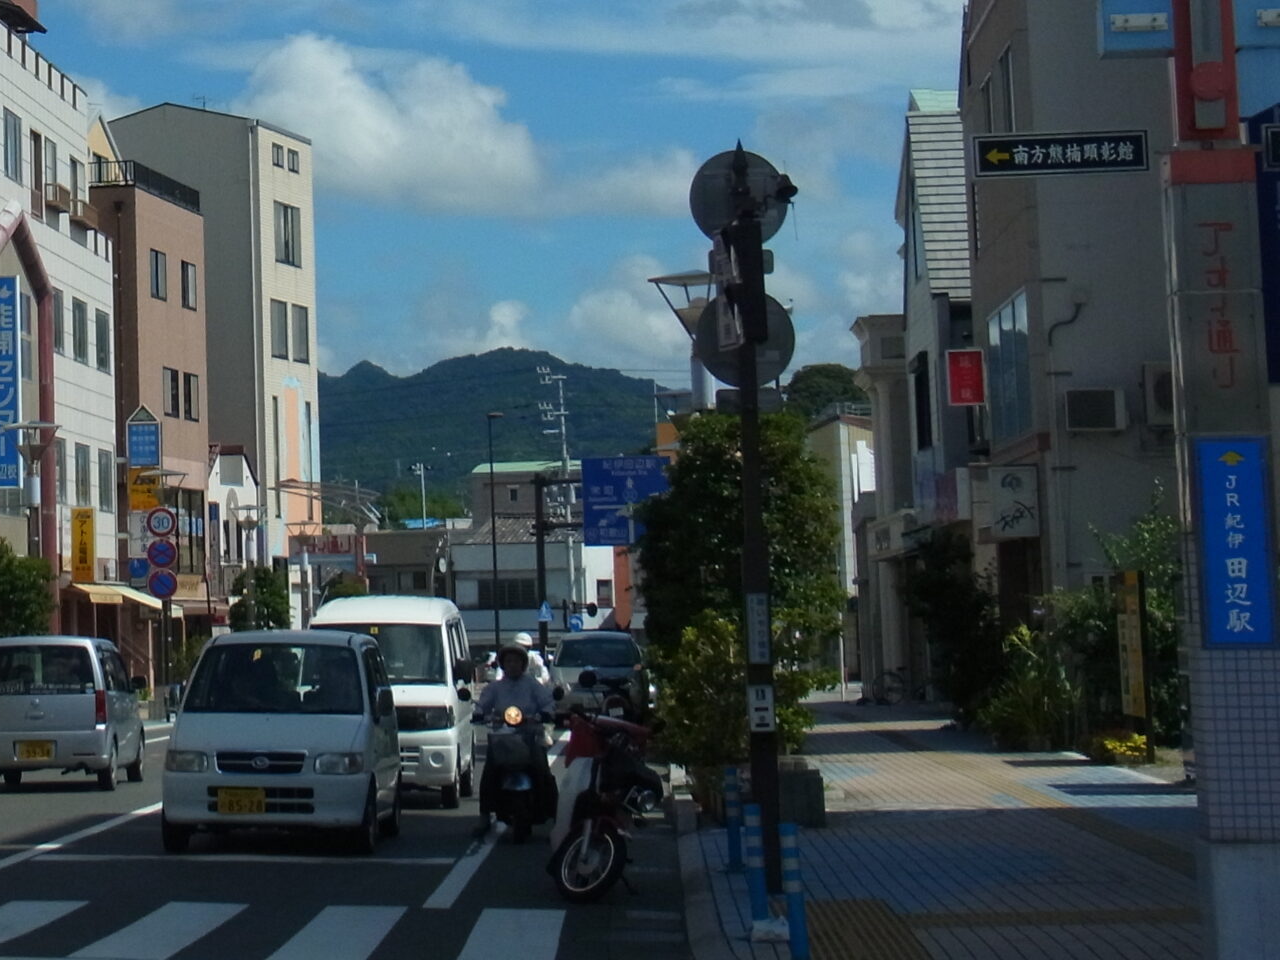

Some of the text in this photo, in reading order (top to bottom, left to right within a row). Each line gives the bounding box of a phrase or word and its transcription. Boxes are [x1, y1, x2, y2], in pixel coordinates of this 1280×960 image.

[152, 516, 170, 530] 30
[1224, 474, 1254, 633] JR紀伊田辺駅
